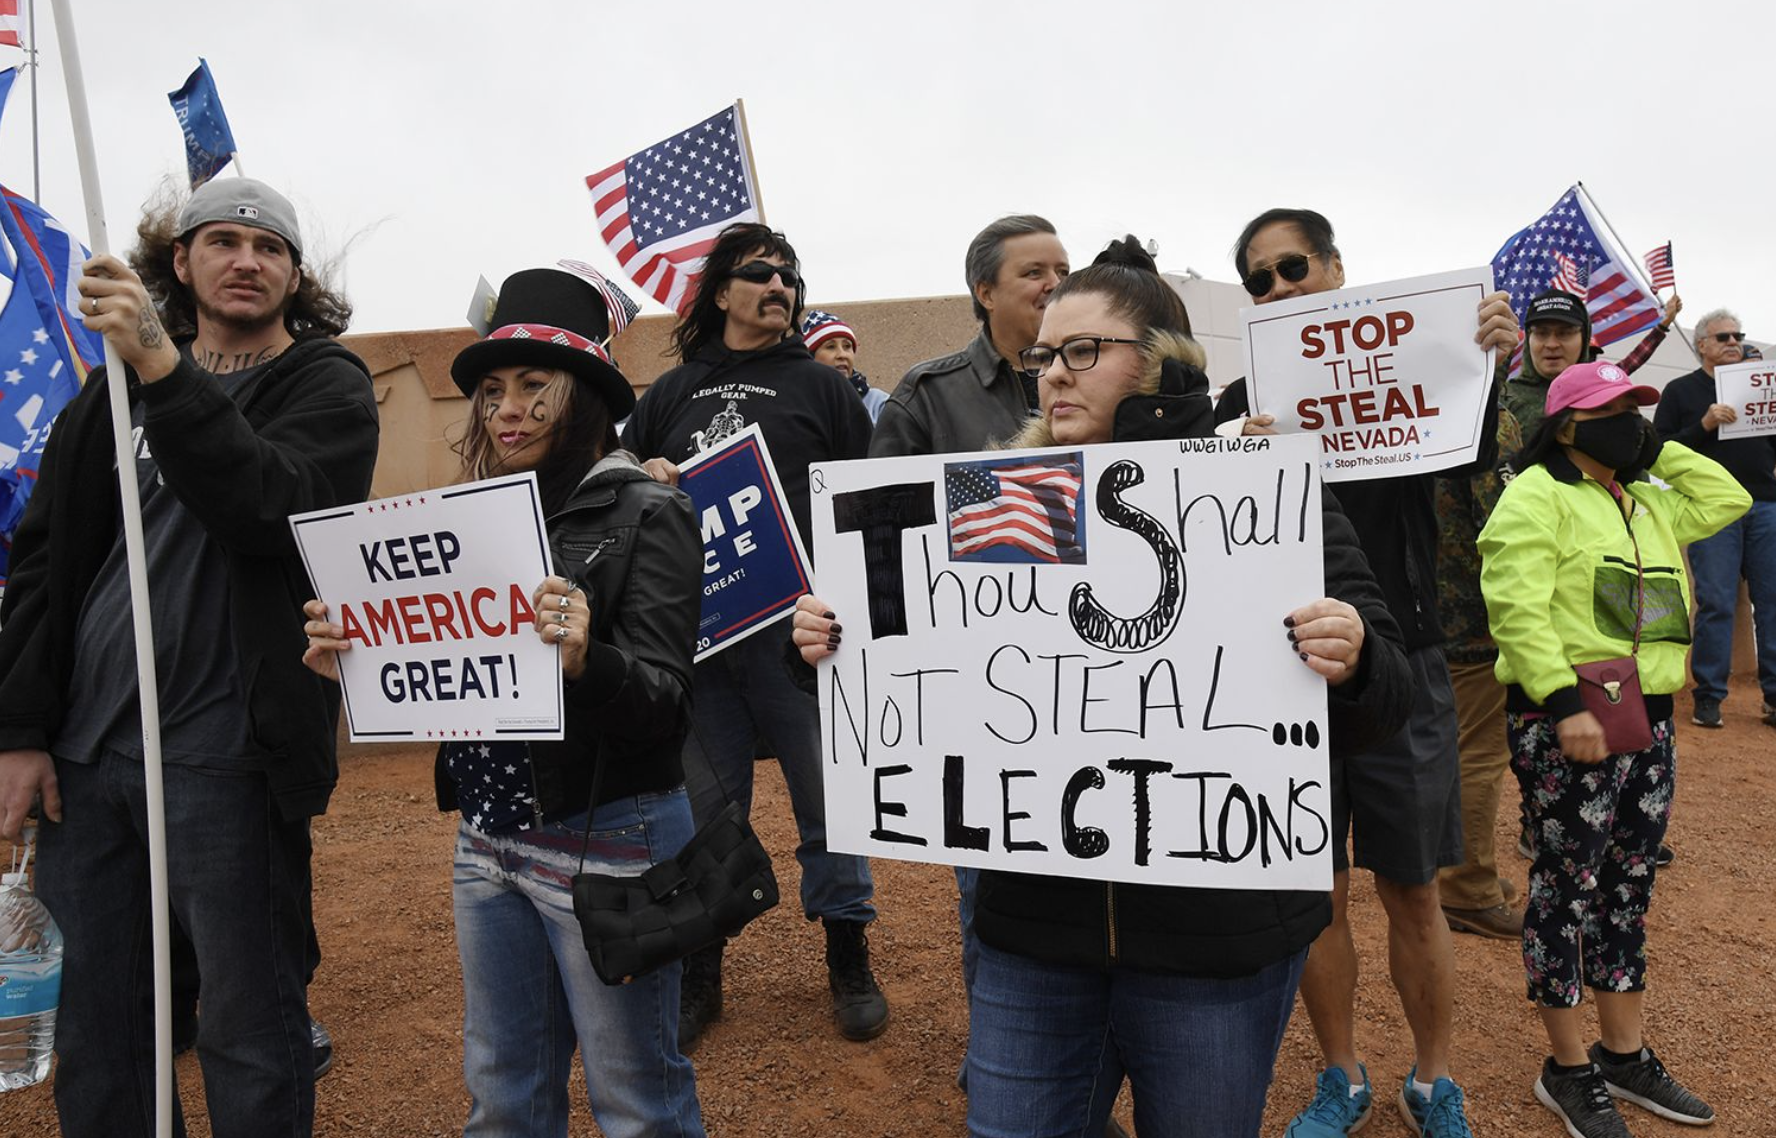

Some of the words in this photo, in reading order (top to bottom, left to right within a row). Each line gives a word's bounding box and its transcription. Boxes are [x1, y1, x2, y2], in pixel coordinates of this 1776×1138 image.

[1300, 310, 1415, 359] STOP
[691, 383, 737, 399] LEGALLY
[738, 383, 777, 397] PUMPED
[1324, 353, 1398, 390] THE
[1750, 372, 1776, 388] ST
[1296, 384, 1440, 430] STEAL
[1321, 425, 1420, 453] NEVADA
[359, 530, 461, 583] KEEP
[832, 481, 1058, 640] Thou
[1068, 458, 1312, 654] Shall
[703, 568, 746, 596] GREAT!
[340, 583, 537, 648] AMERICA
[380, 653, 520, 703] GREAT!
[869, 754, 1329, 868] ELECTIONS
